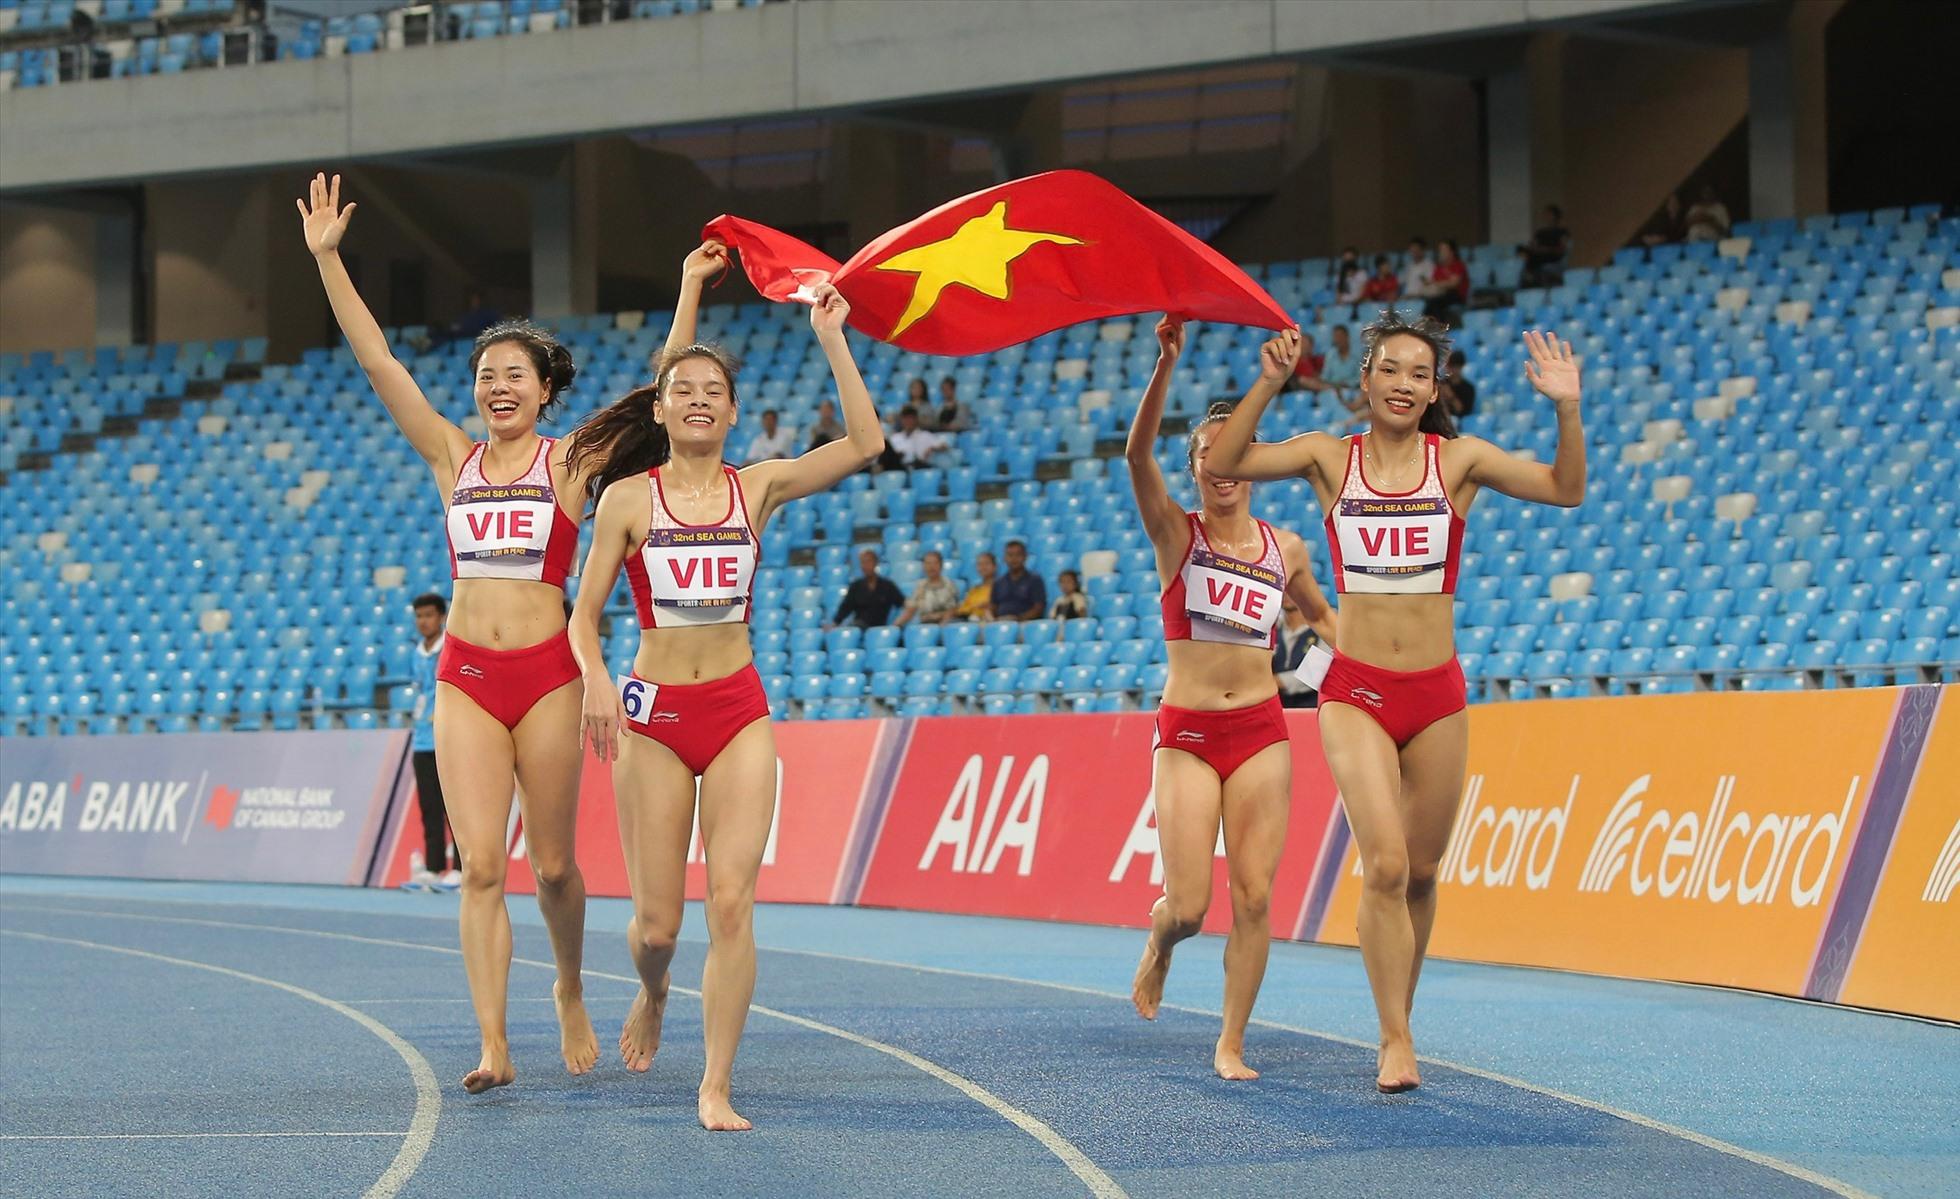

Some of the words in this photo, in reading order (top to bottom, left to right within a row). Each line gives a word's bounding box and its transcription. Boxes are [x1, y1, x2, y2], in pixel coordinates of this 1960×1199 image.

[471, 489, 491, 499] 32nd
[492, 488, 509, 498] SEA
[511, 487, 542, 498] GAMES
[1363, 504, 1383, 512] 32nd
[1384, 503, 1402, 512] SEA
[1404, 502, 1436, 511] GAMES
[466, 510, 534, 541] VIE
[672, 533, 695, 542] 32nd
[696, 532, 714, 541] SEA
[716, 531, 742, 541] GAMES
[1358, 526, 1429, 557] VIE
[667, 556, 738, 589] VIE
[1215, 558, 1235, 570] 32nd
[1235, 564, 1251, 575] SEA
[1252, 568, 1276, 584] GAMES
[1206, 577, 1267, 620] VIE
[623, 681, 645, 718] 6
[0, 781, 68, 832] ABA
[78, 781, 189, 832] BANK
[299, 787, 335, 807] BANK
[918, 754, 1049, 876] AIA
[1438, 774, 1581, 891] llcard
[1629, 775, 1860, 907] cellcard
